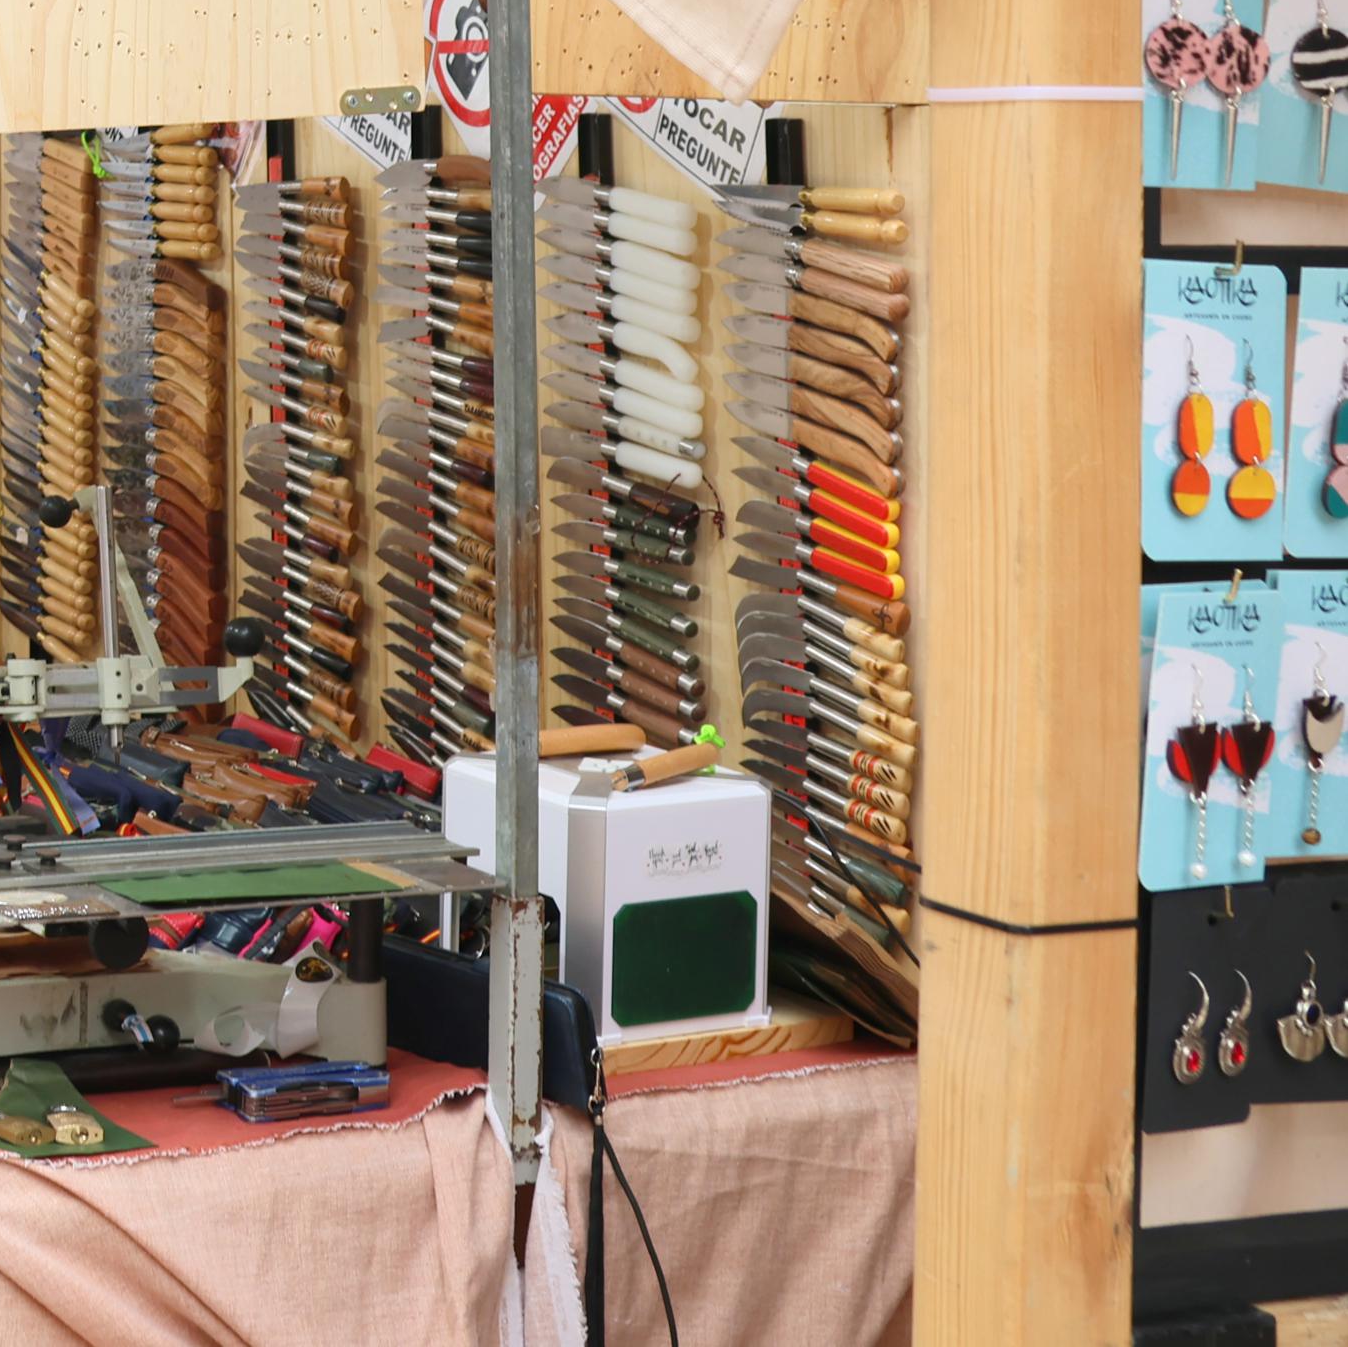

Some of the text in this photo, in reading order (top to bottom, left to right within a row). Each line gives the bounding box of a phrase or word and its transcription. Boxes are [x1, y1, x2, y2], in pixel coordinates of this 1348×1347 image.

[532, 103, 556, 148] CER
[533, 96, 585, 181] OGRAFIAS
[659, 114, 741, 186] PREGUNTE
